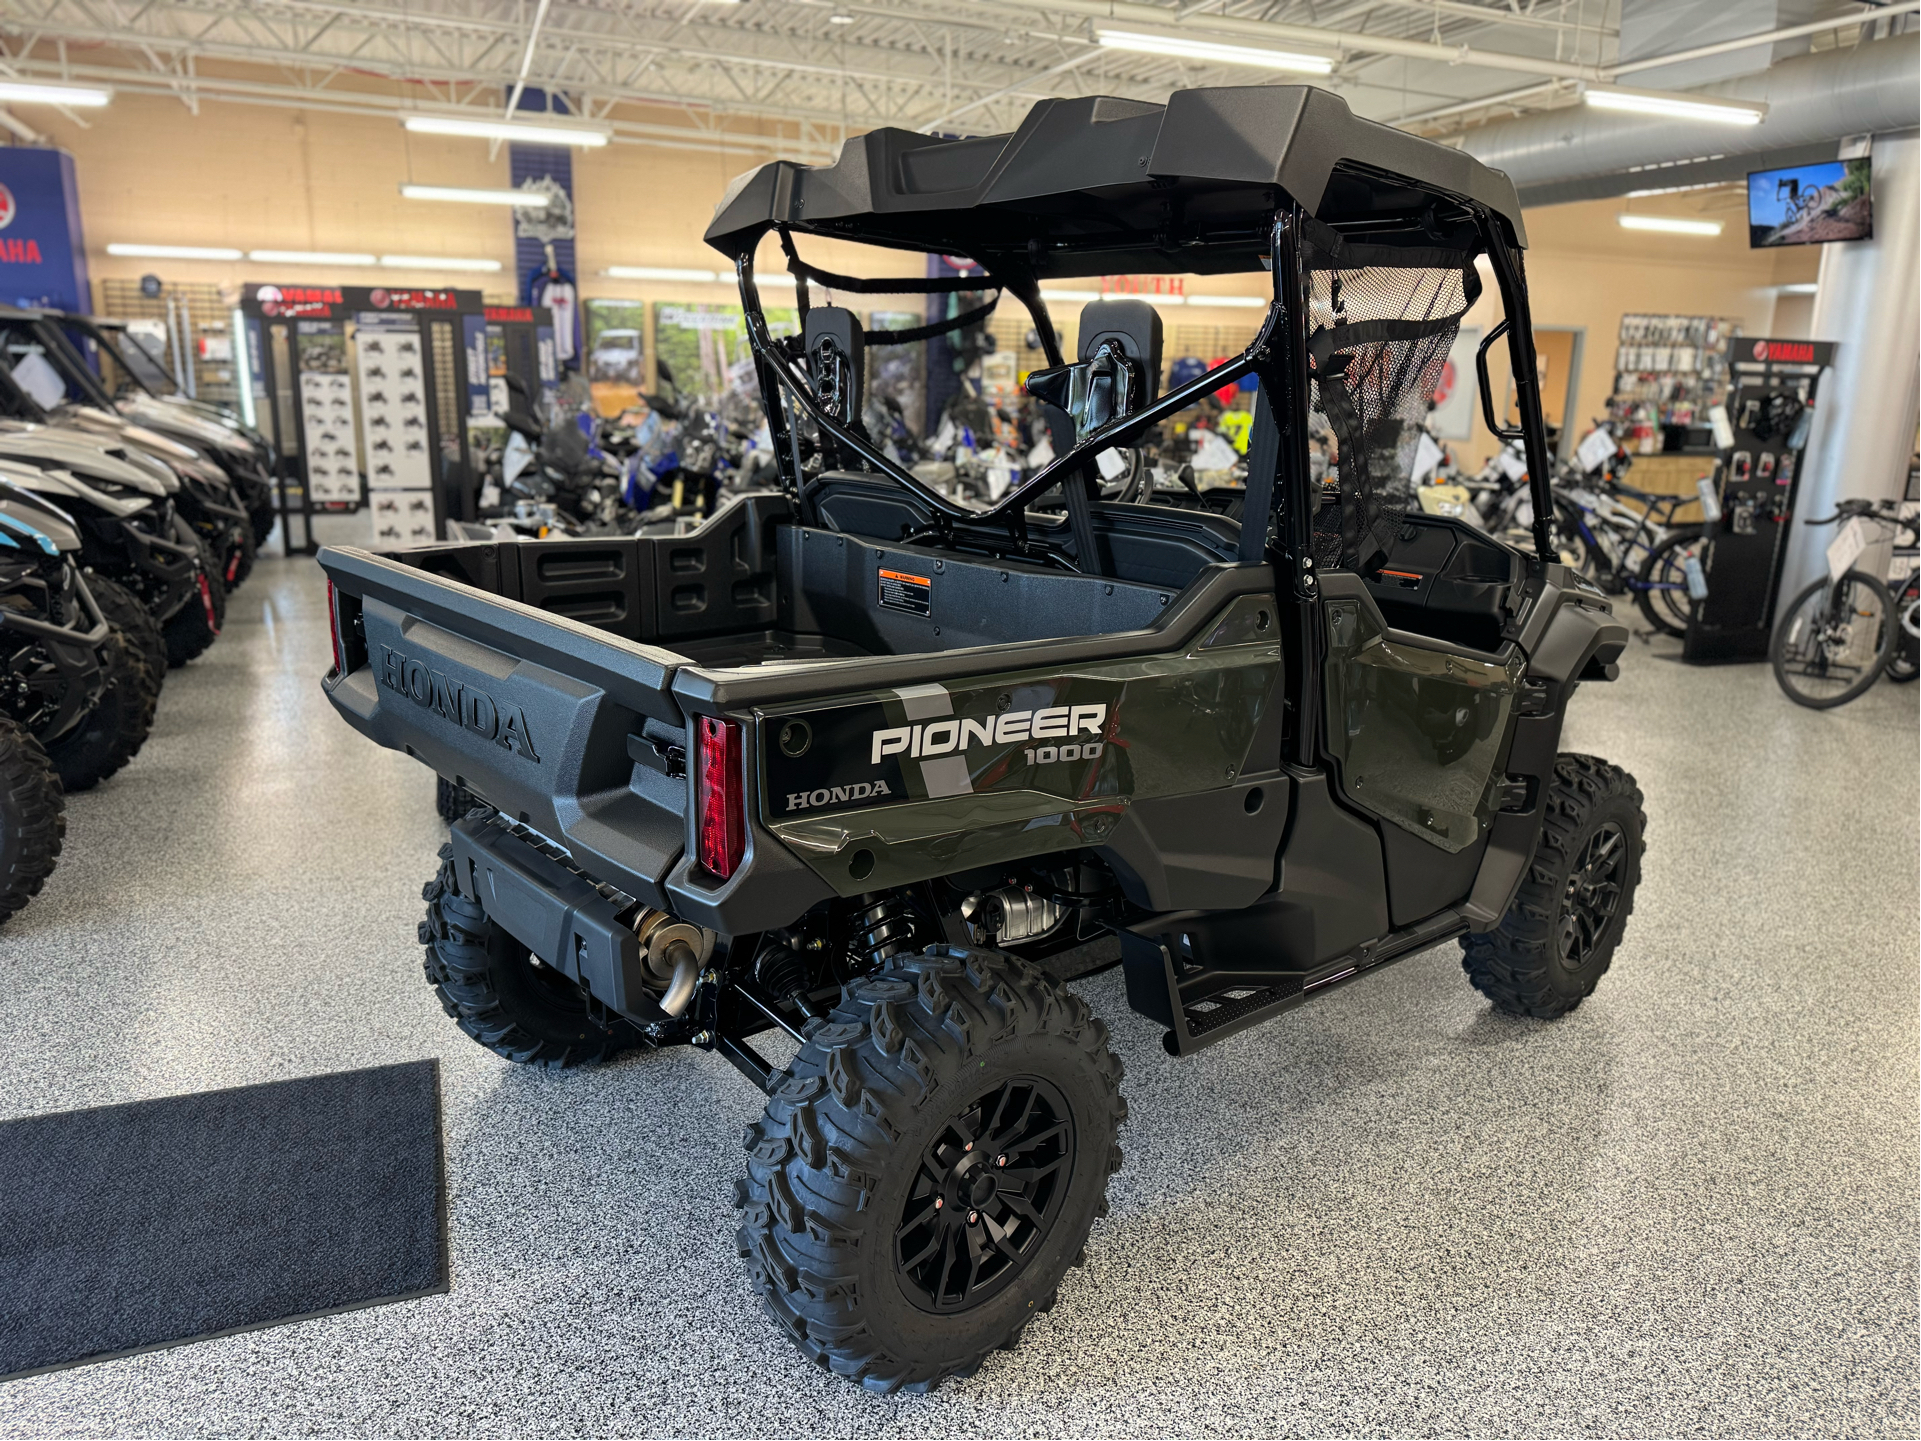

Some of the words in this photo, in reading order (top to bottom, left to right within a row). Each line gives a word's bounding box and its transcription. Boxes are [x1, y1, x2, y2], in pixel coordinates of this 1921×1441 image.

[1101, 274, 1184, 297] YOUTH
[483, 307, 534, 322] YAMAHA
[1768, 342, 1814, 362] YAMAHA
[380, 643, 540, 764] HONDA
[871, 703, 1107, 765] PIONEER
[1024, 742, 1104, 766] 1000
[785, 779, 891, 812] HONDA
